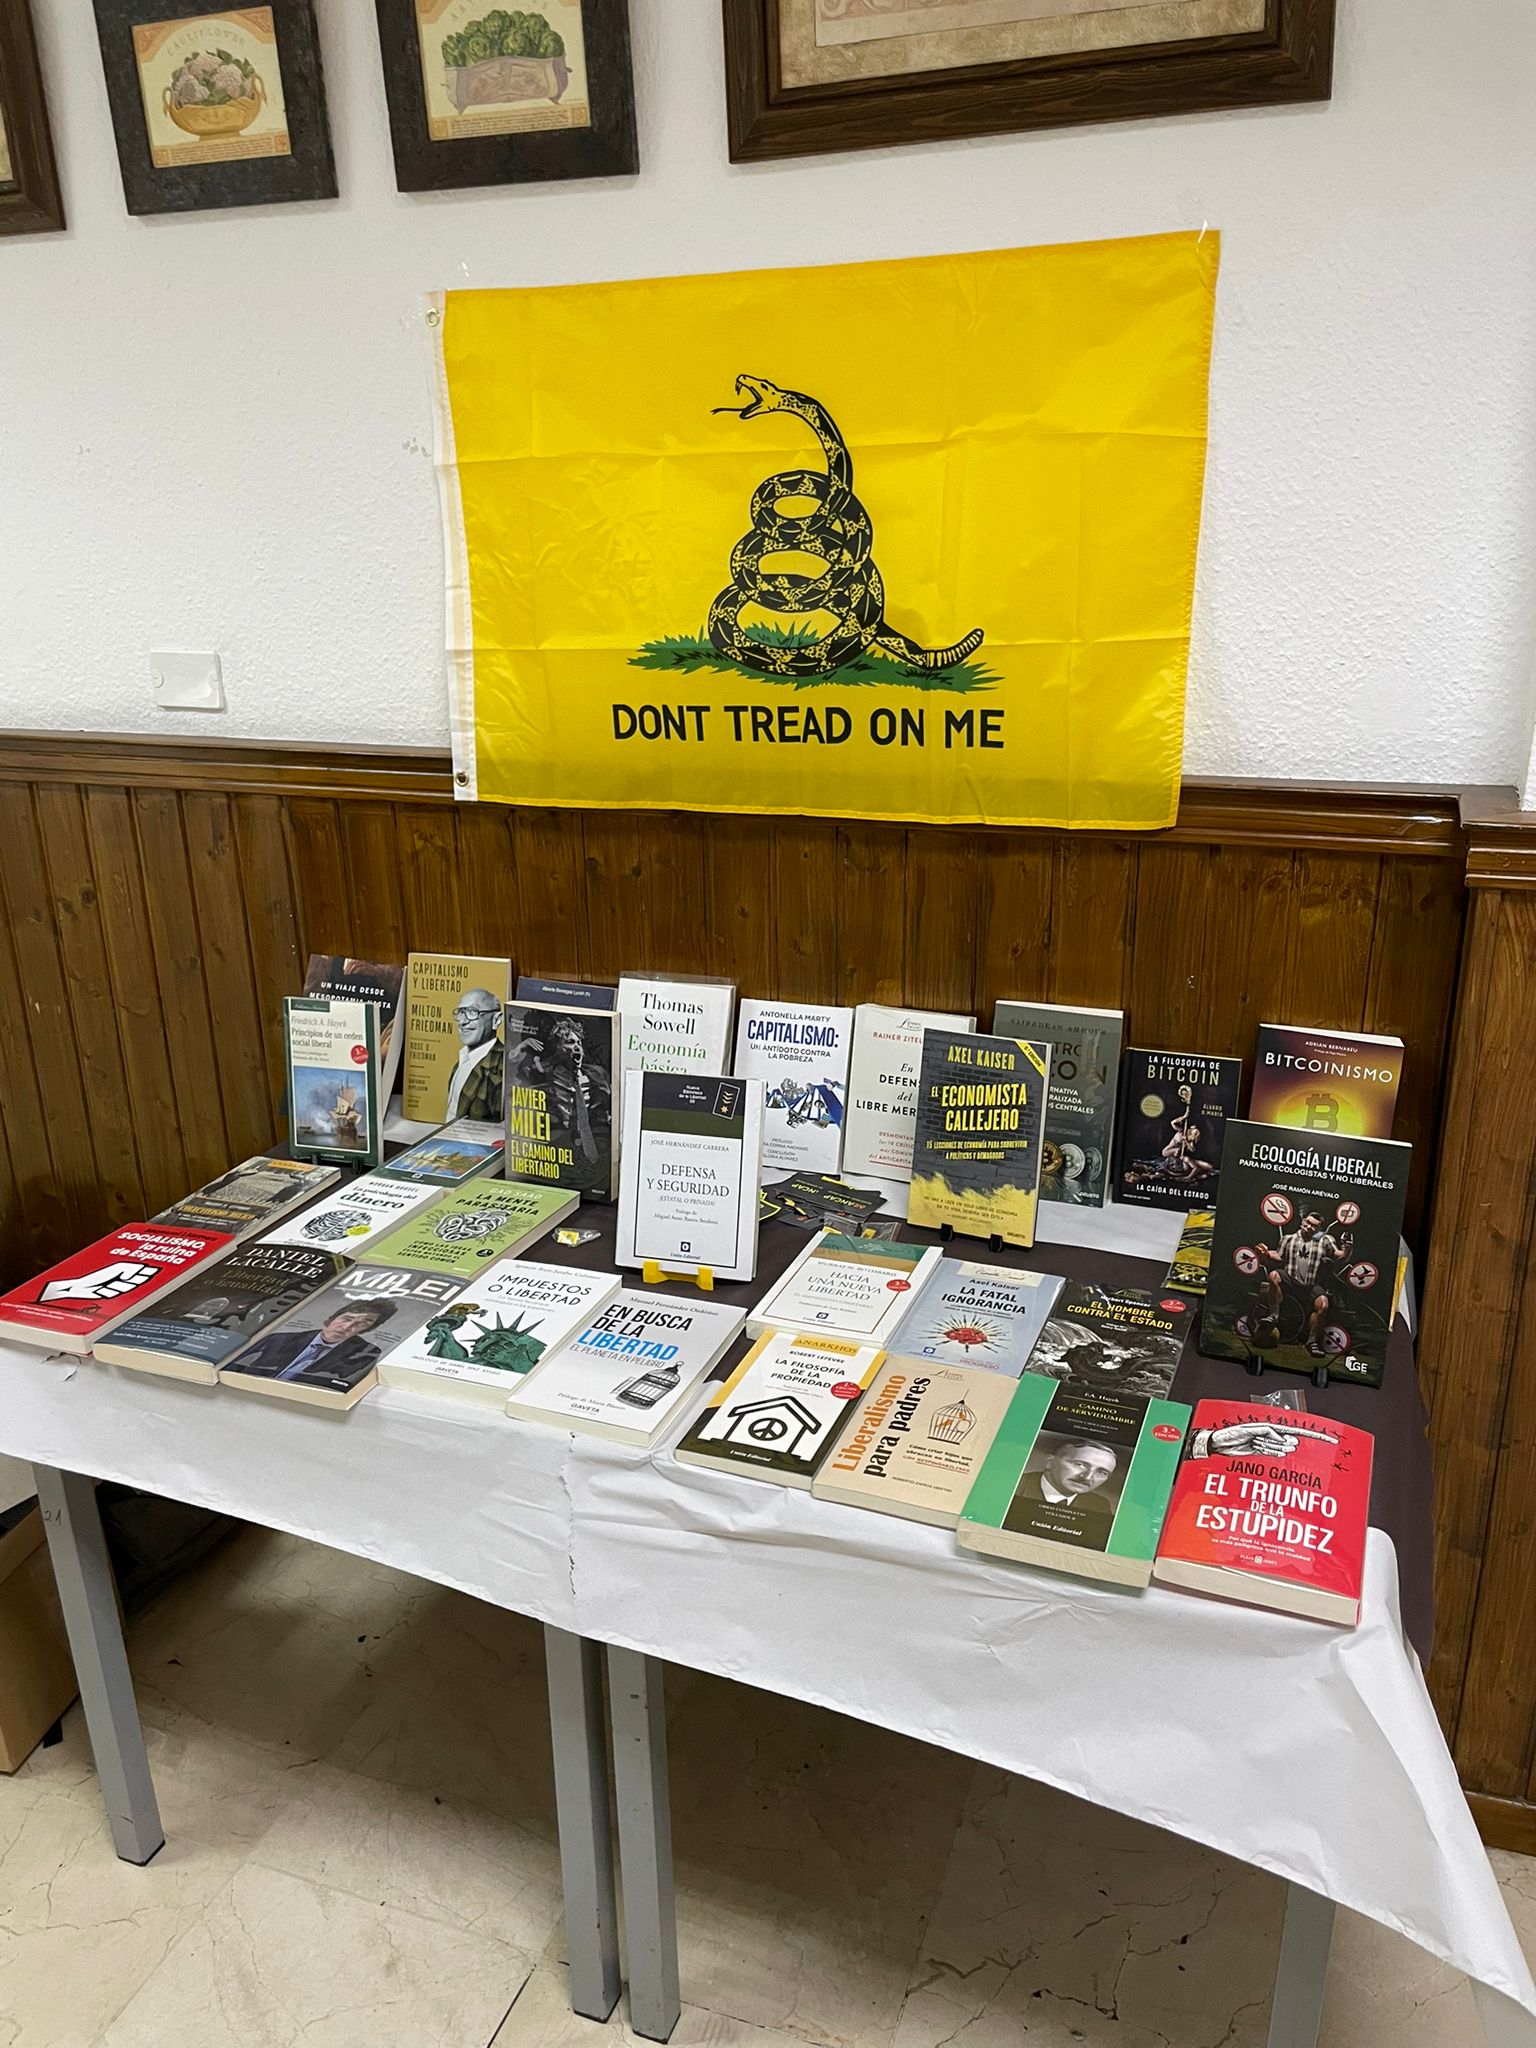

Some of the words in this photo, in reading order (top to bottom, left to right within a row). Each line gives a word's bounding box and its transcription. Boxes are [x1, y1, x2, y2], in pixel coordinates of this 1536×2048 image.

[612, 704, 710, 741] DONT
[724, 705, 852, 744] TREAD
[869, 708, 925, 747] ON
[944, 709, 1005, 748] ME
[413, 962, 469, 979] CAPITALISMO
[320, 981, 333, 989] UN
[335, 983, 356, 993] VIAJE
[360, 986, 385, 996] DESDE
[413, 977, 419, 989] Y
[422, 978, 462, 993] LIBERTAD
[411, 1004, 442, 1018] MILTON
[640, 992, 704, 1015] Thomas
[643, 1014, 695, 1035] Sowell
[759, 1010, 803, 1021] ANTONELLA
[804, 1014, 831, 1023] MARTY
[291, 1028, 324, 1038] Principios
[324, 1030, 332, 1038] de
[344, 1032, 363, 1041] orden
[410, 1019, 453, 1034] FRIEDMAN
[747, 1019, 839, 1048] CAPITALISMO:
[311, 1040, 332, 1048] liberal
[872, 1031, 900, 1041] RAINER
[627, 1034, 707, 1060] Economía
[762, 1044, 799, 1055] ANTÍDOTO
[800, 1048, 831, 1058] CONTRA
[1305, 1041, 1327, 1049] ADRIÁN
[768, 1052, 778, 1060] LA
[779, 1053, 814, 1063] POBREZA
[947, 1045, 973, 1065] AXEL
[976, 1049, 1015, 1071] KAISER
[1148, 1055, 1159, 1064] LA
[1162, 1057, 1206, 1068] FILOSOFÍA
[1209, 1062, 1220, 1070] DE
[900, 1063, 913, 1073] En
[1147, 1064, 1220, 1086] BITCOIN
[1265, 1052, 1393, 1083] BITCOINISMO
[879, 1074, 920, 1088] DEFEN
[512, 1085, 547, 1111] JAVIER
[896, 1091, 913, 1102] del
[931, 1086, 940, 1098] EL
[941, 1083, 1027, 1107] ECONOMISTA
[856, 1099, 888, 1113] LIBRE
[1055, 1103, 1094, 1114] CENTRALES
[511, 1109, 551, 1142] MILEI
[945, 1109, 1019, 1131] CALLEJERO
[511, 1140, 521, 1157] EL
[522, 1143, 557, 1163] CAMINO
[558, 1147, 574, 1166] DEL
[665, 1140, 702, 1149] HERNÁNDEZ
[511, 1157, 560, 1179] LIBERTARIO
[1251, 1143, 1320, 1170] ECOLOGÍA
[1324, 1154, 1382, 1179] LIBERAL
[661, 1163, 716, 1180] DEFENSA
[1239, 1159, 1259, 1168] PARA
[1260, 1162, 1272, 1170] NO
[1273, 1164, 1328, 1179] ECOLOGISTAS
[1336, 1175, 1348, 1183] NO
[1349, 1177, 1394, 1190] LIBERALES
[489, 1187, 514, 1196] GAD
[517, 1190, 543, 1199] SAAD
[646, 1178, 654, 1189] Y
[656, 1178, 730, 1197] SEGURIDAD
[1136, 1183, 1145, 1191] LA
[1146, 1184, 1167, 1194] CAÍDA
[1169, 1188, 1181, 1197] DEL
[1183, 1190, 1209, 1200] ESTADO
[1272, 1183, 1288, 1191] JOSÉ
[1289, 1185, 1311, 1194] RAMÓN
[1311, 1189, 1340, 1199] ARÉVALO
[340, 1192, 405, 1209] dinero
[455, 1198, 539, 1216] PARASITARIA
[497, 1196, 539, 1207] MENTE
[117, 1231, 205, 1251] SOCIALISMO,
[138, 1241, 154, 1250] la
[155, 1245, 197, 1258] ruina
[109, 1247, 129, 1256] de
[130, 1250, 187, 1265] España
[245, 1248, 327, 1268] DANIEL
[407, 1244, 467, 1256] INFECCIOSAS
[224, 1257, 324, 1280] LACALLE
[221, 1269, 291, 1287] Libertad
[497, 1273, 592, 1296] IMPUESTOS
[807, 1276, 836, 1287] UNA
[837, 1280, 882, 1294] NUEVA
[829, 1271, 870, 1284] HACIA
[991, 1281, 1020, 1291] Kaiser
[487, 1284, 503, 1293] O
[505, 1286, 582, 1306] LIBERTAD
[807, 1285, 871, 1301] LIBERTAD
[960, 1286, 976, 1296] LA
[979, 1289, 1017, 1303] FATAL
[941, 1293, 1026, 1315] IGNORANCIA
[1090, 1301, 1103, 1310] EL
[1106, 1303, 1155, 1318] HOMBRE
[603, 1303, 634, 1320] EN
[630, 1308, 694, 1332] BUSCA
[1066, 1304, 1111, 1319] CONTRA
[1113, 1313, 1127, 1322] EL
[1129, 1316, 1173, 1331] ESTADO
[591, 1316, 622, 1333] DE
[618, 1322, 646, 1338] LA
[577, 1328, 680, 1362] LIBERTAD
[794, 1339, 858, 1354] ANARKHOS
[569, 1344, 583, 1352] EL
[583, 1345, 619, 1361] PLANETA
[618, 1353, 632, 1363] EN
[630, 1355, 666, 1369] PELIGRO
[789, 1350, 815, 1358] ROBERT
[775, 1358, 788, 1366] LA
[790, 1361, 845, 1376] FILOSOFÍA
[790, 1368, 804, 1376] DE
[807, 1371, 820, 1379] LA
[770, 1372, 832, 1389] PROPIEDAD
[570, 1402, 600, 1413] GAVETA
[1078, 1403, 1118, 1415] CAMINO
[832, 1374, 907, 1472] Liberalismo
[1070, 1408, 1136, 1426] SERVIDUMBRE
[863, 1435, 901, 1478] para
[887, 1377, 931, 1433] padres
[1226, 1460, 1265, 1477] JANO
[1269, 1466, 1322, 1490] GARCÍA
[1203, 1473, 1229, 1496] EL
[1239, 1477, 1337, 1519] TRIUNFO
[1250, 1500, 1267, 1513] DE
[1269, 1504, 1284, 1517] LA
[1030, 1519, 1052, 1530] Unión
[1052, 1524, 1083, 1536] Editorial
[1196, 1504, 1335, 1555] ESTUPIDEZ
[1234, 1541, 1264, 1551] peligrosa
[1285, 1551, 1311, 1562] maldad
[1261, 1541, 1295, 1553] ignorancia
